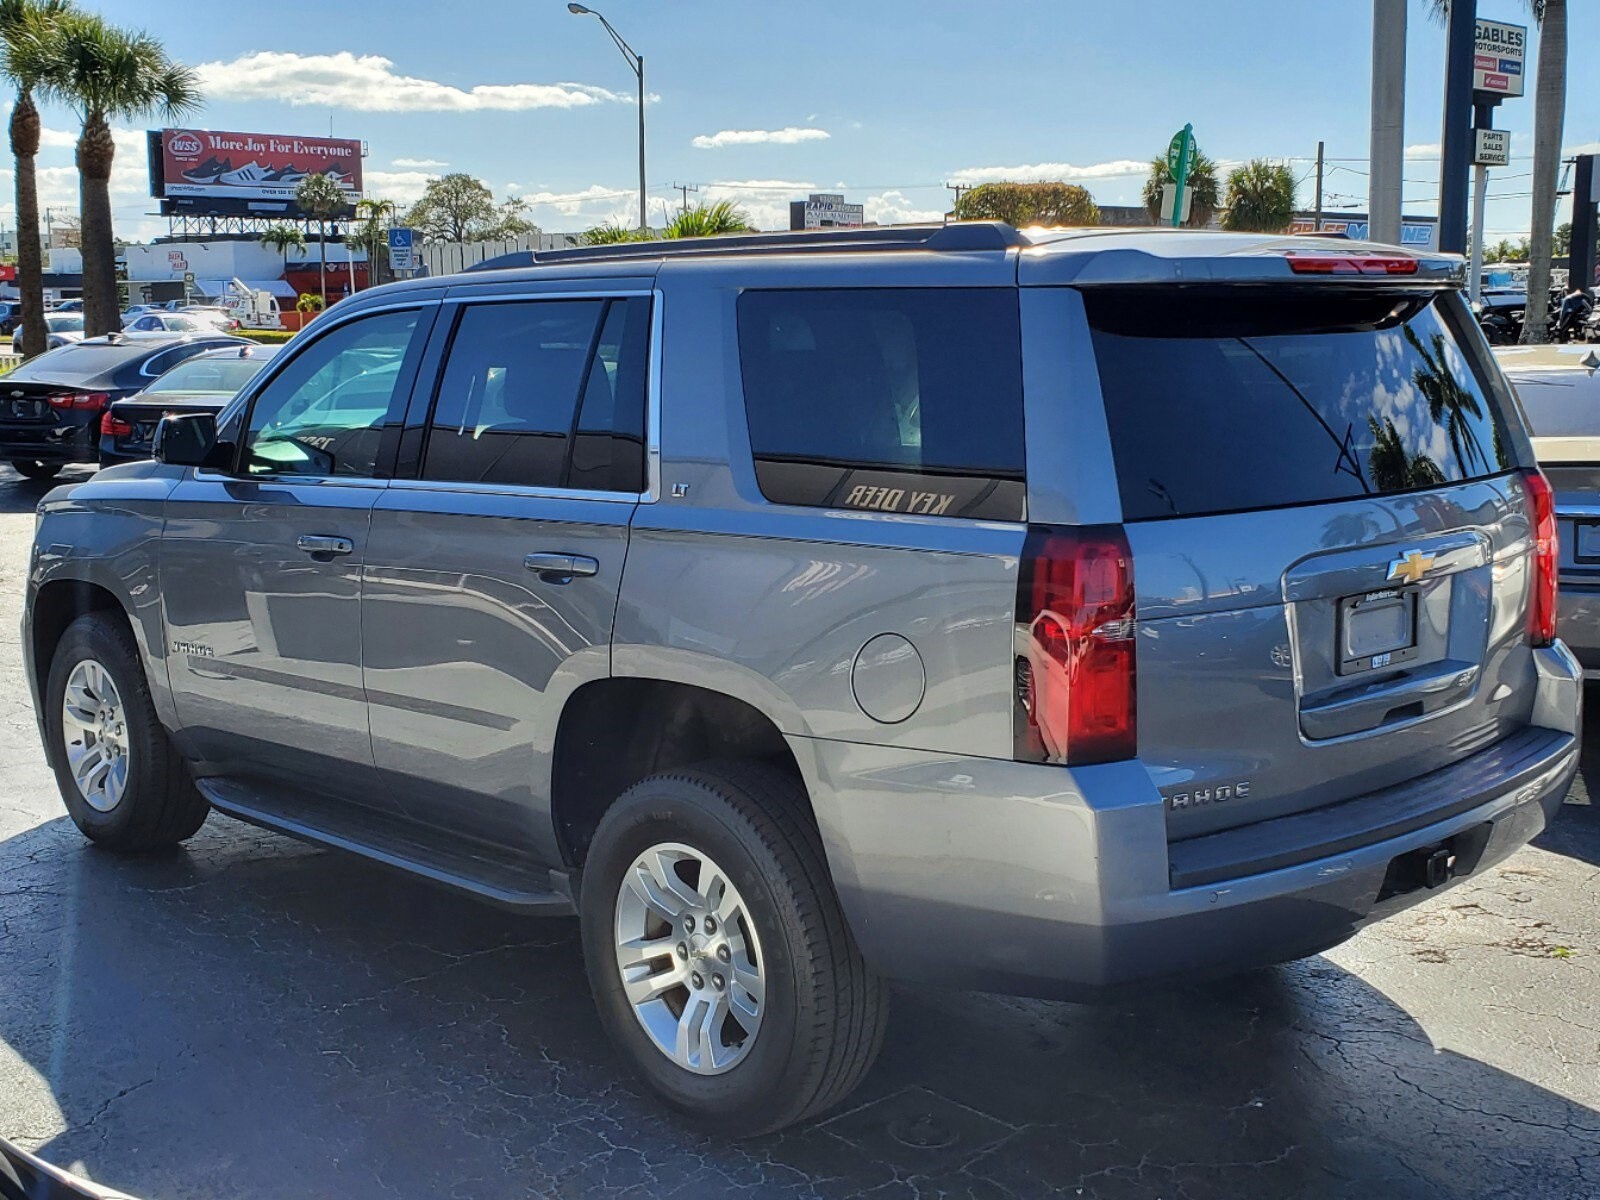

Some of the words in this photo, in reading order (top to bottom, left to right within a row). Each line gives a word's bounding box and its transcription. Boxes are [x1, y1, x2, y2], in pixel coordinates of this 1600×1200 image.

[1475, 25, 1523, 47] GABLES
[1483, 132, 1503, 141] PARTS
[173, 140, 198, 152] WSS
[208, 135, 243, 151] More
[244, 138, 266, 157] Joy
[269, 140, 291, 153] For
[293, 141, 352, 159] Everyone
[1483, 142, 1503, 151] SALES
[1479, 153, 1506, 162] SERVICE
[671, 482, 689, 498] LT
[1162, 781, 1250, 808] AHOE
